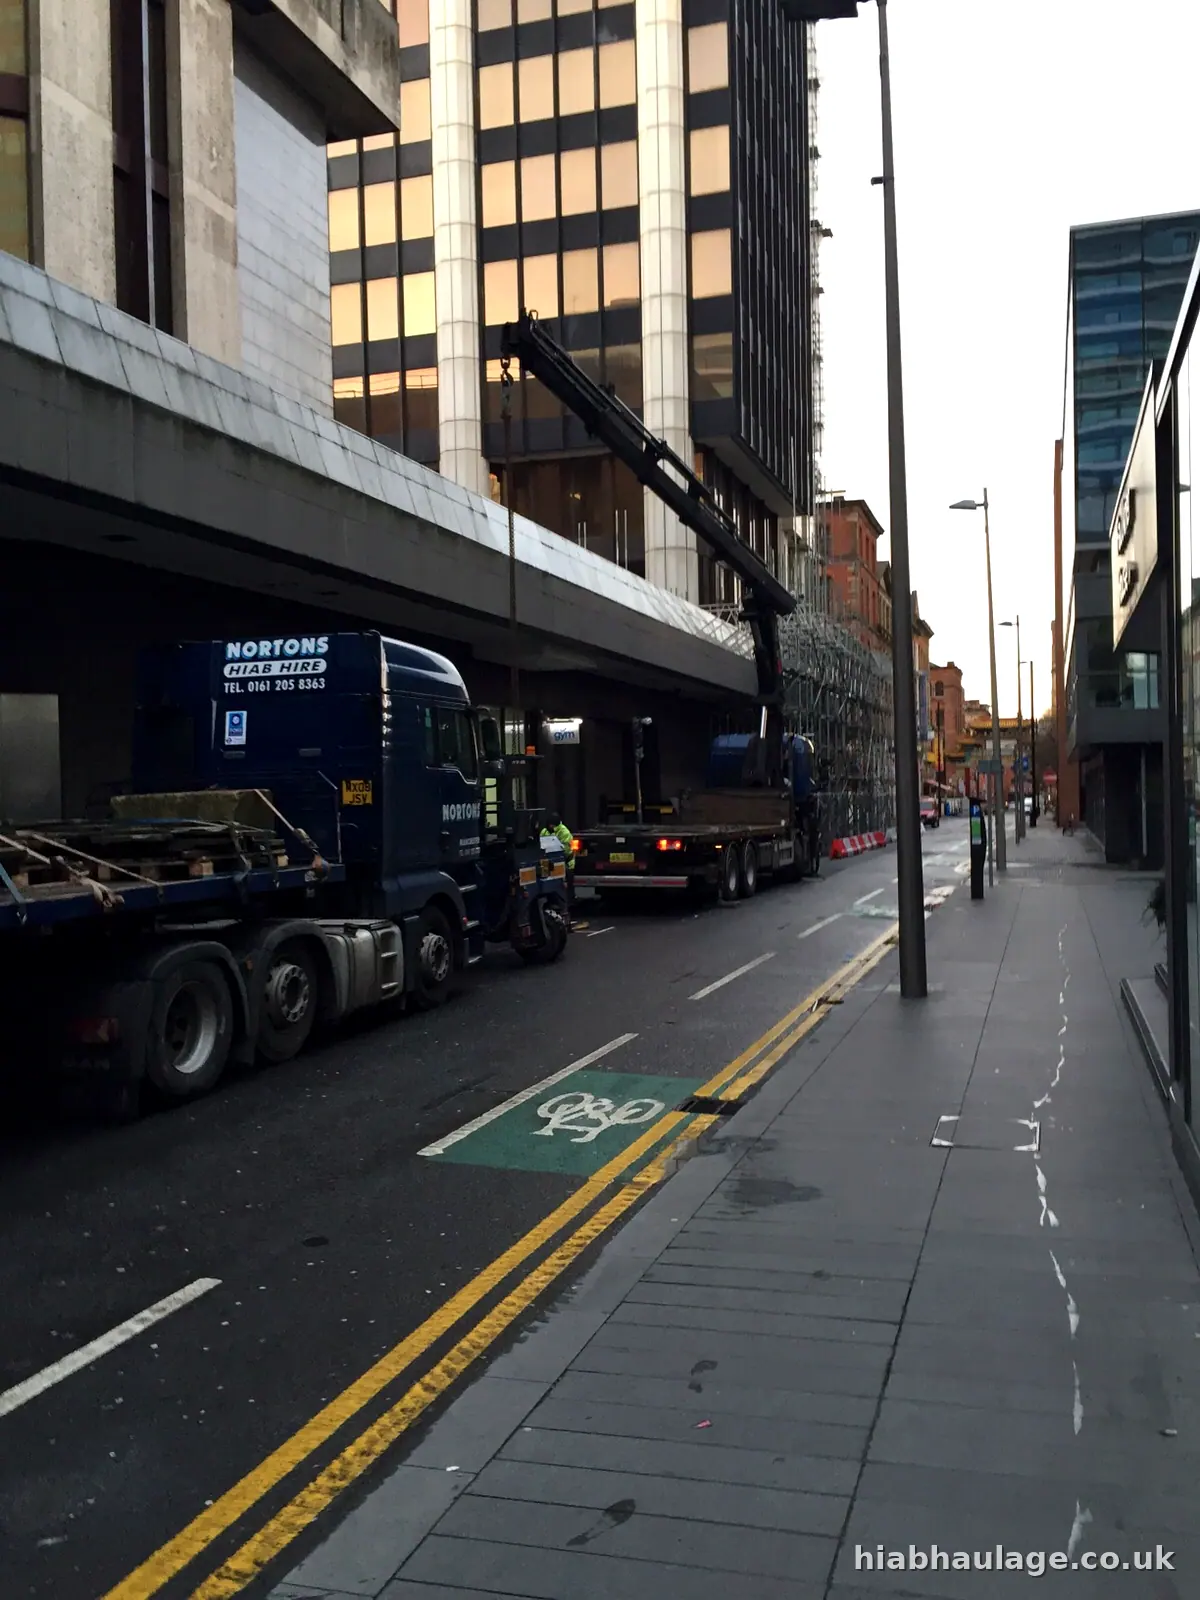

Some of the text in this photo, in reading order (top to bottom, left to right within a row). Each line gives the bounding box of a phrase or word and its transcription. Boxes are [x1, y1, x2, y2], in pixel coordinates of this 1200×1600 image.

[226, 637, 329, 659] NORTONS
[228, 661, 322, 676] HIAB HIRE
[224, 678, 326, 693] TEL. 0161 205 8363
